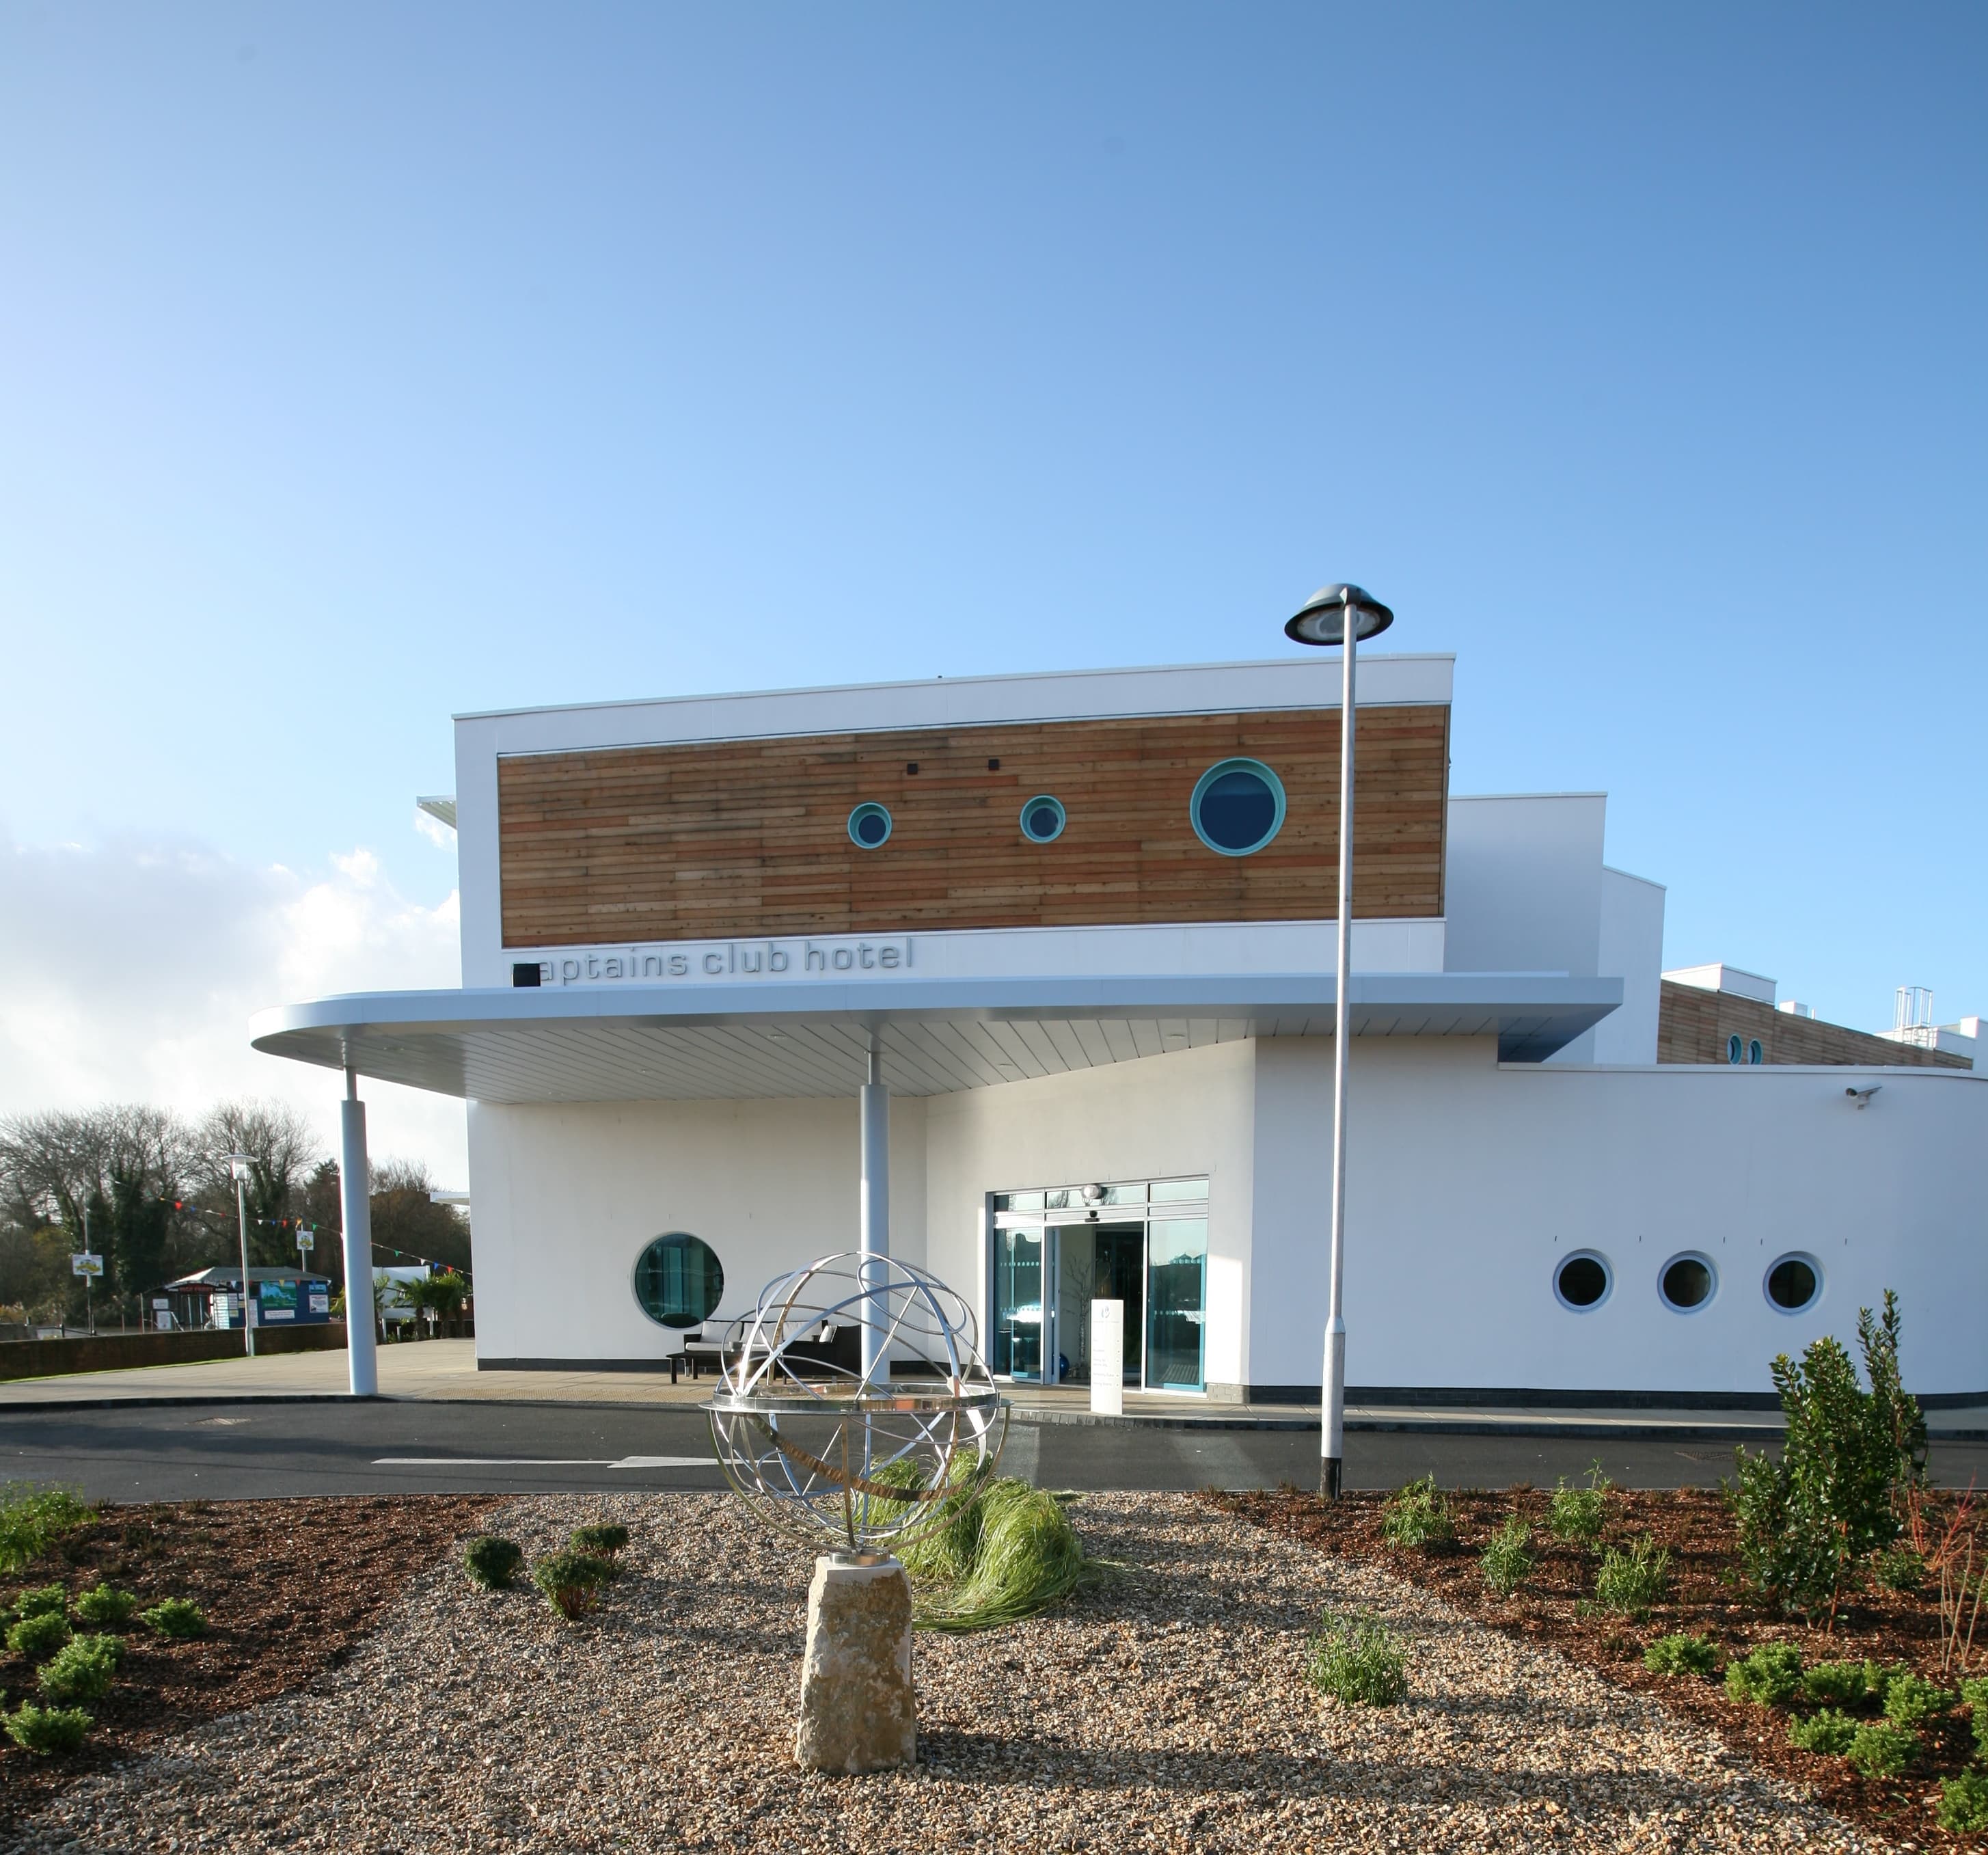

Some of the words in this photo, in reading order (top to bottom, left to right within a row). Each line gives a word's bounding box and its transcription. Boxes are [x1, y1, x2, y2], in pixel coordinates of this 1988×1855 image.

[514, 947, 687, 986] aptains
[702, 942, 789, 974] club
[804, 937, 912, 971] hotel
